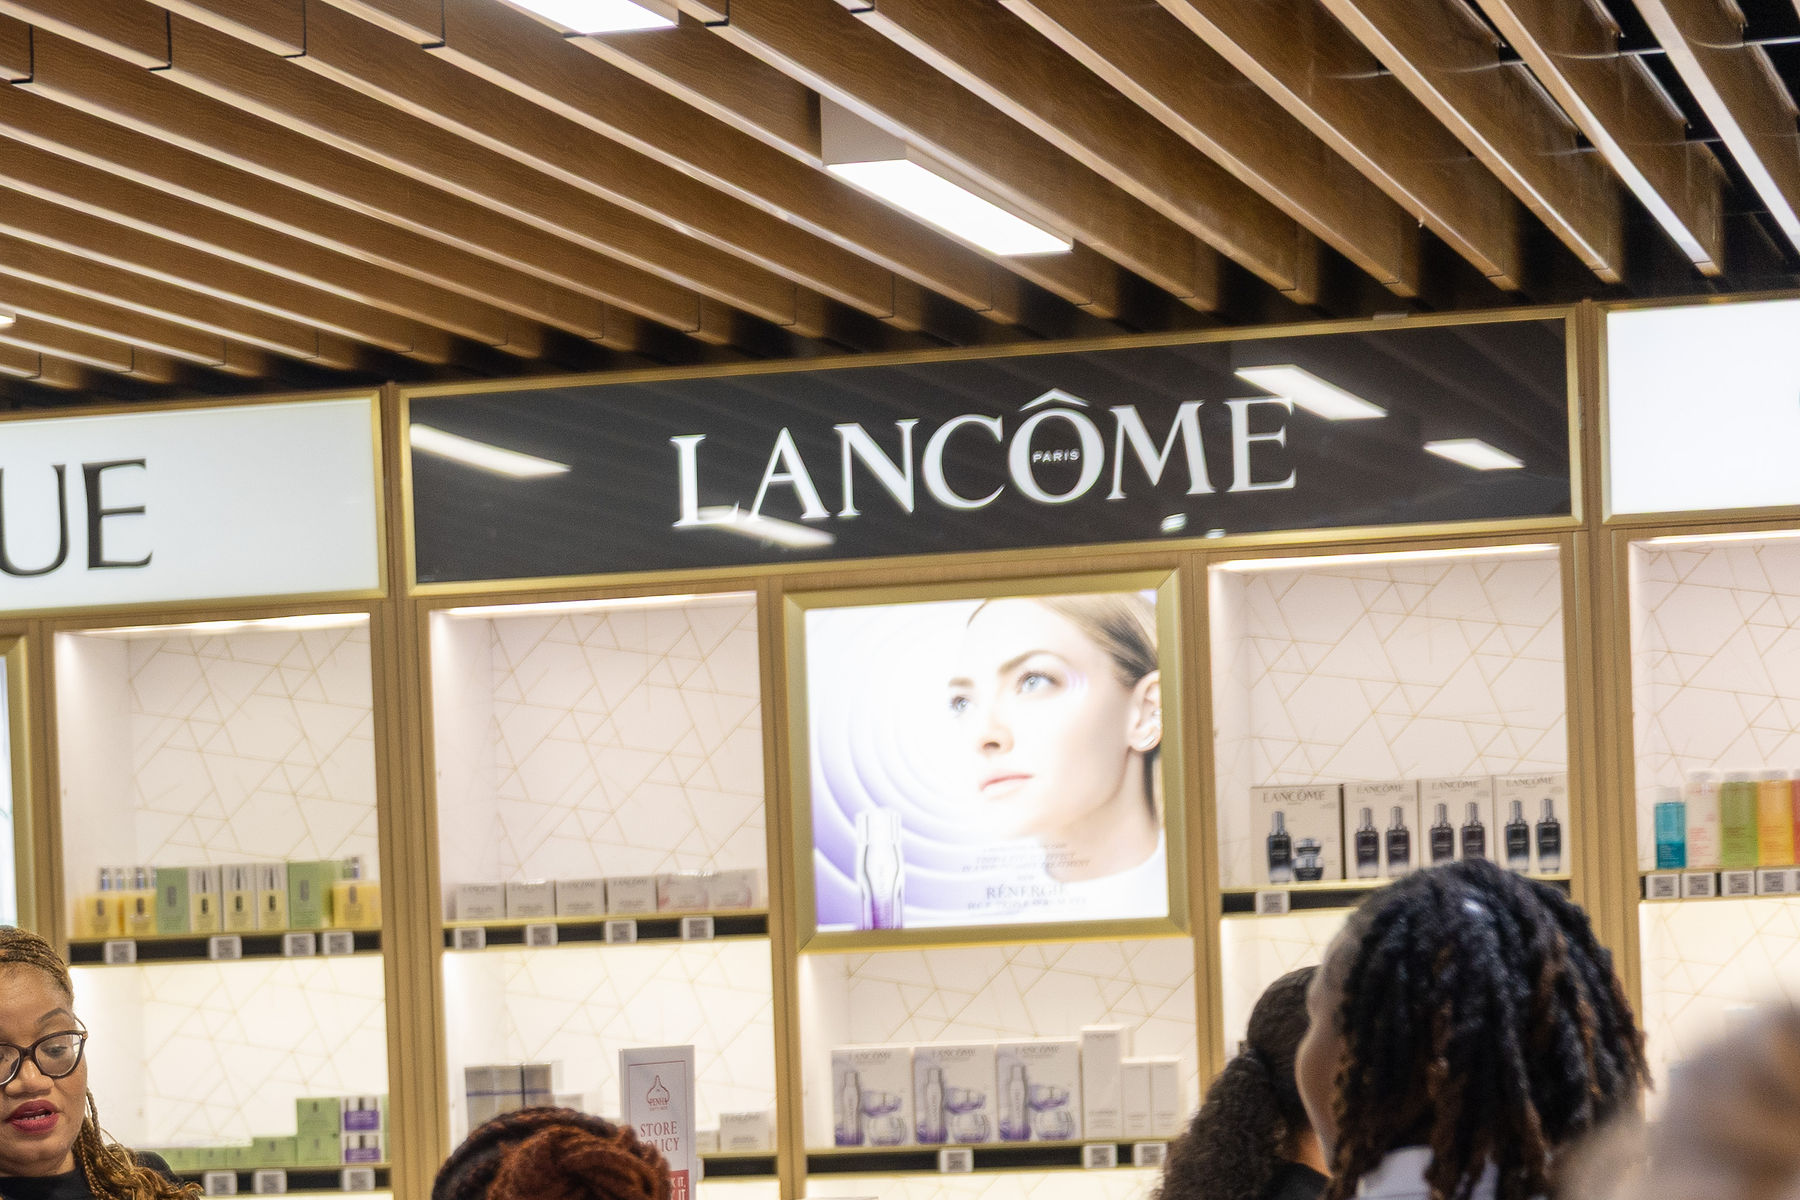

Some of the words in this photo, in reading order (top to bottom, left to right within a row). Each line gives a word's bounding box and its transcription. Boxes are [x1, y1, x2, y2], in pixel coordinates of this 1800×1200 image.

[670, 389, 1297, 527] LANCÔME
[1032, 448, 1080, 463] PARIS
[640, 1121, 678, 1138] STORE
